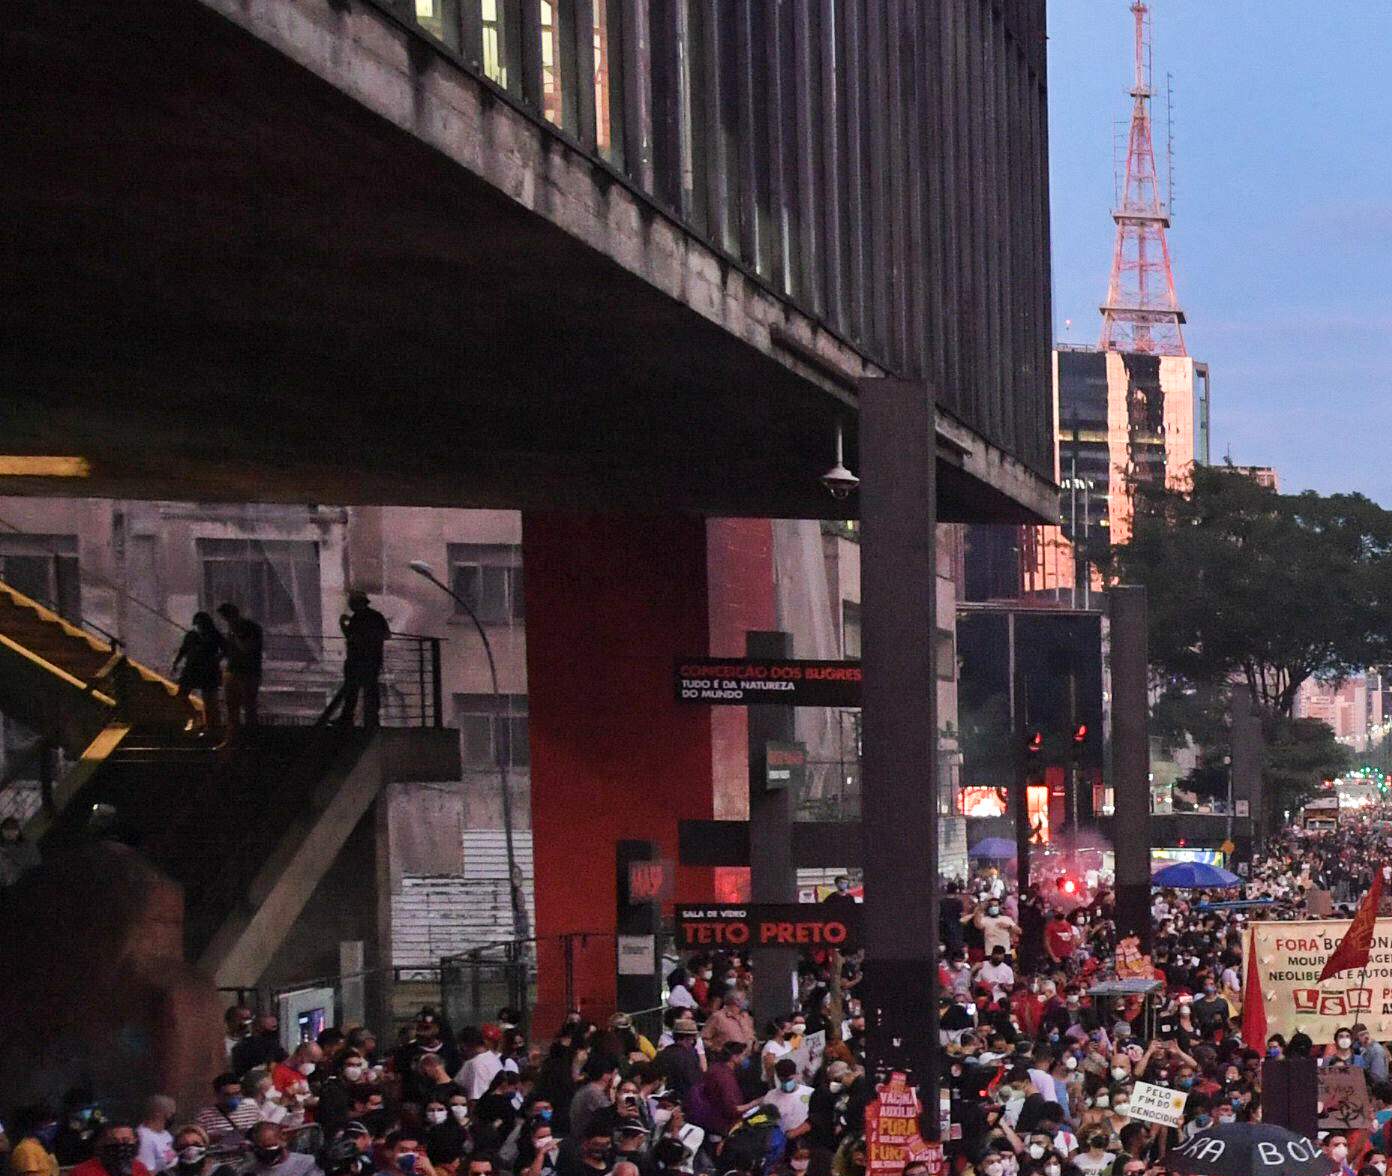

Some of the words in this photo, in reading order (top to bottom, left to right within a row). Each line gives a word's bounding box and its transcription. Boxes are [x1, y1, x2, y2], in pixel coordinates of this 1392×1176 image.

[771, 666, 800, 680] DOS
[805, 668, 861, 682] BUGRES
[682, 680, 710, 690] TUDO
[713, 679, 719, 690] É
[722, 681, 737, 690] DA
[741, 681, 795, 691] NATUREZA
[682, 690, 698, 699] DO
[701, 690, 743, 699] MUNDO
[682, 911, 704, 919] SALA
[684, 922, 748, 944] TETO
[761, 922, 847, 944] PRETO
[1277, 938, 1318, 951] FORA
[1270, 968, 1343, 982] NEOLIBEAL
[1146, 1087, 1171, 1099] PELO
[1138, 1095, 1155, 1105] FIM
[1157, 1100, 1170, 1108] DO
